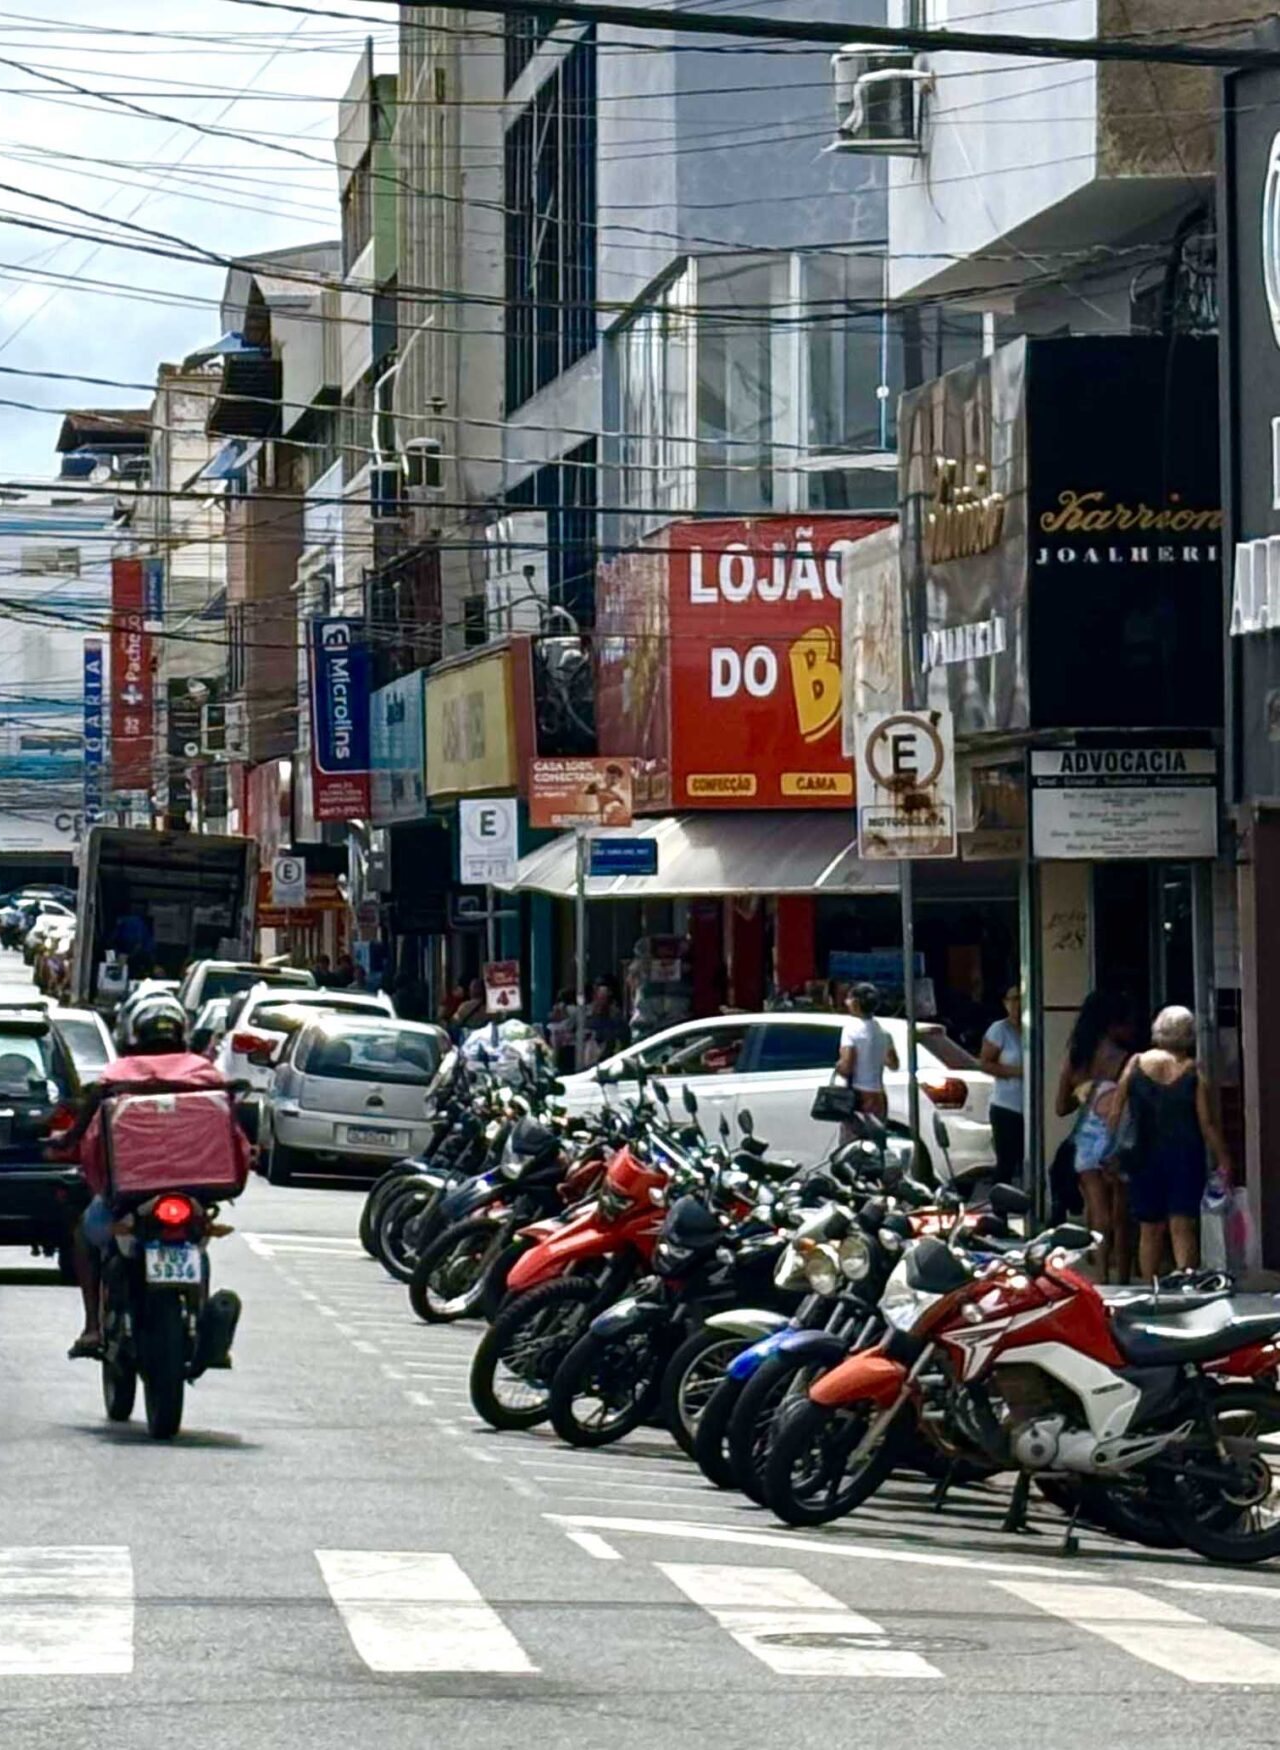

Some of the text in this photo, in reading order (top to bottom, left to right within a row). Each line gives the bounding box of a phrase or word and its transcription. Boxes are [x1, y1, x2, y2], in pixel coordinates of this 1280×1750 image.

[710, 644, 778, 698] DO
[330, 658, 353, 760] Microlins
[892, 734, 918, 774] E
[1060, 751, 1187, 773] ADVOCACIA
[796, 776, 838, 791] CAMA
[480, 810, 497, 836] E
[283, 863, 294, 880] E
